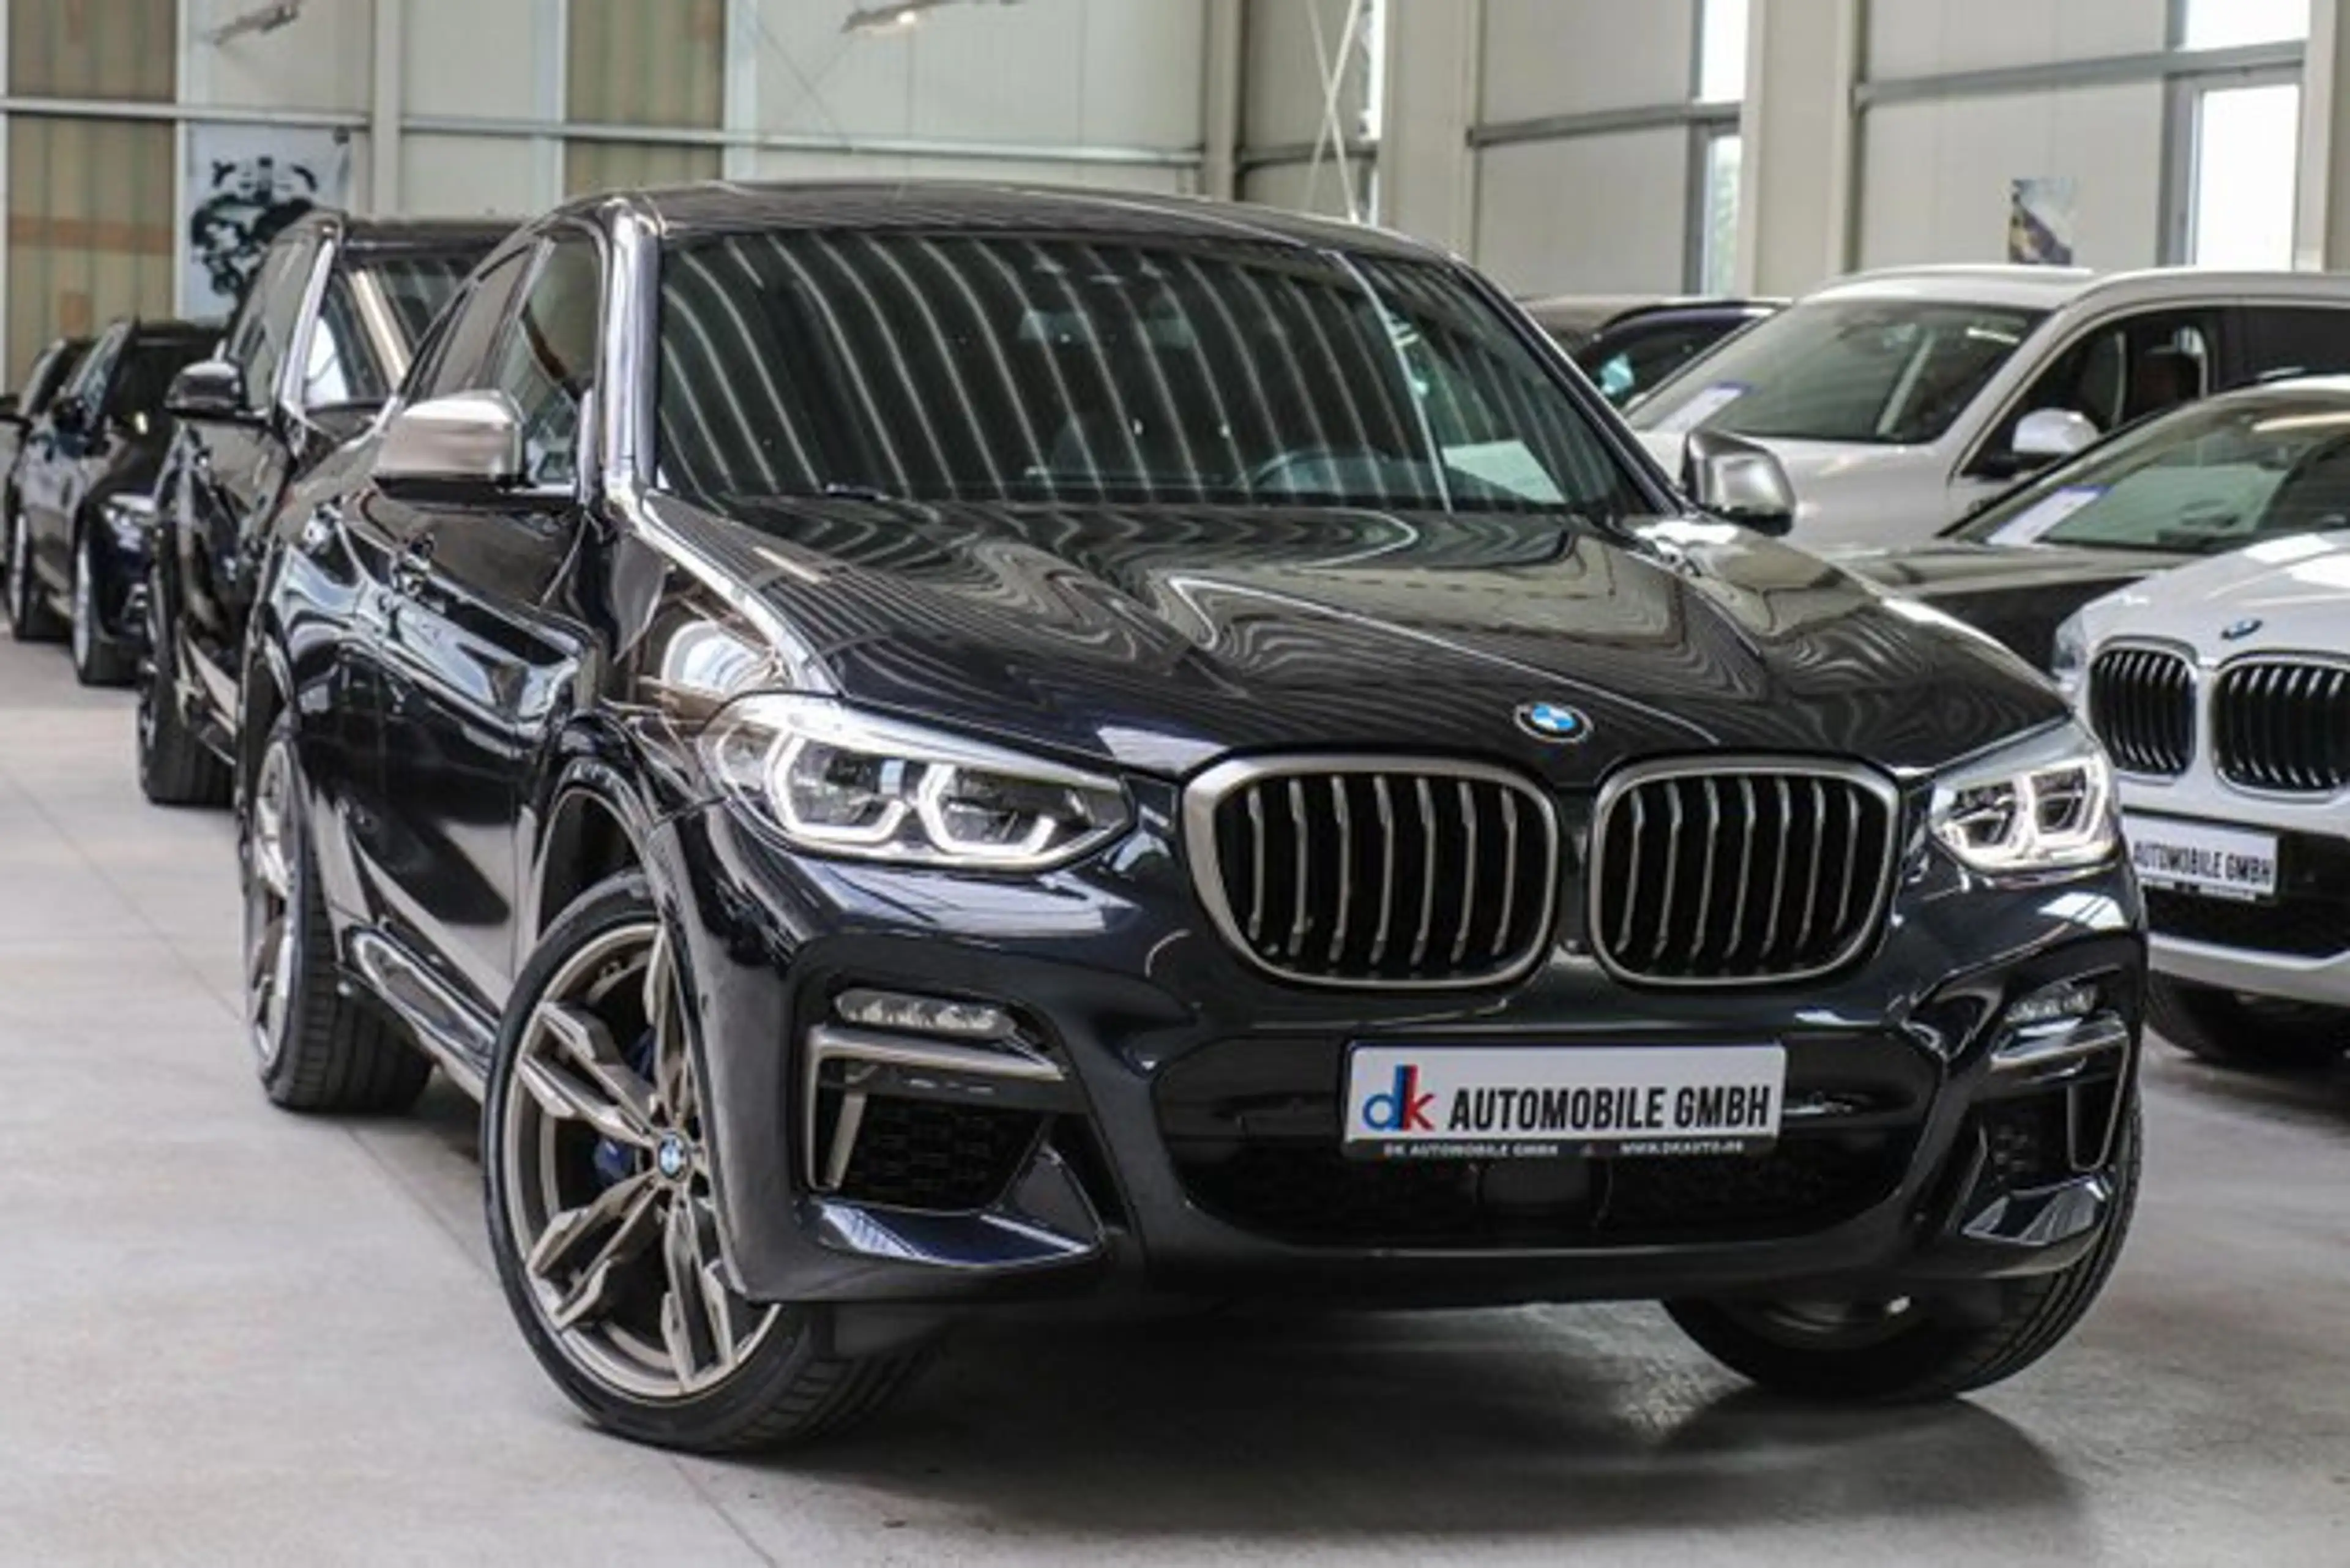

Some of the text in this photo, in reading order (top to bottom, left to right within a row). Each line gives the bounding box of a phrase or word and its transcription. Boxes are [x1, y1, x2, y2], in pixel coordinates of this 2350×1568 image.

[2132, 840, 2271, 886] AUTOMOBILE GMBH
[1362, 1064, 1771, 1131] dk AUTOMOBILE GMBH
